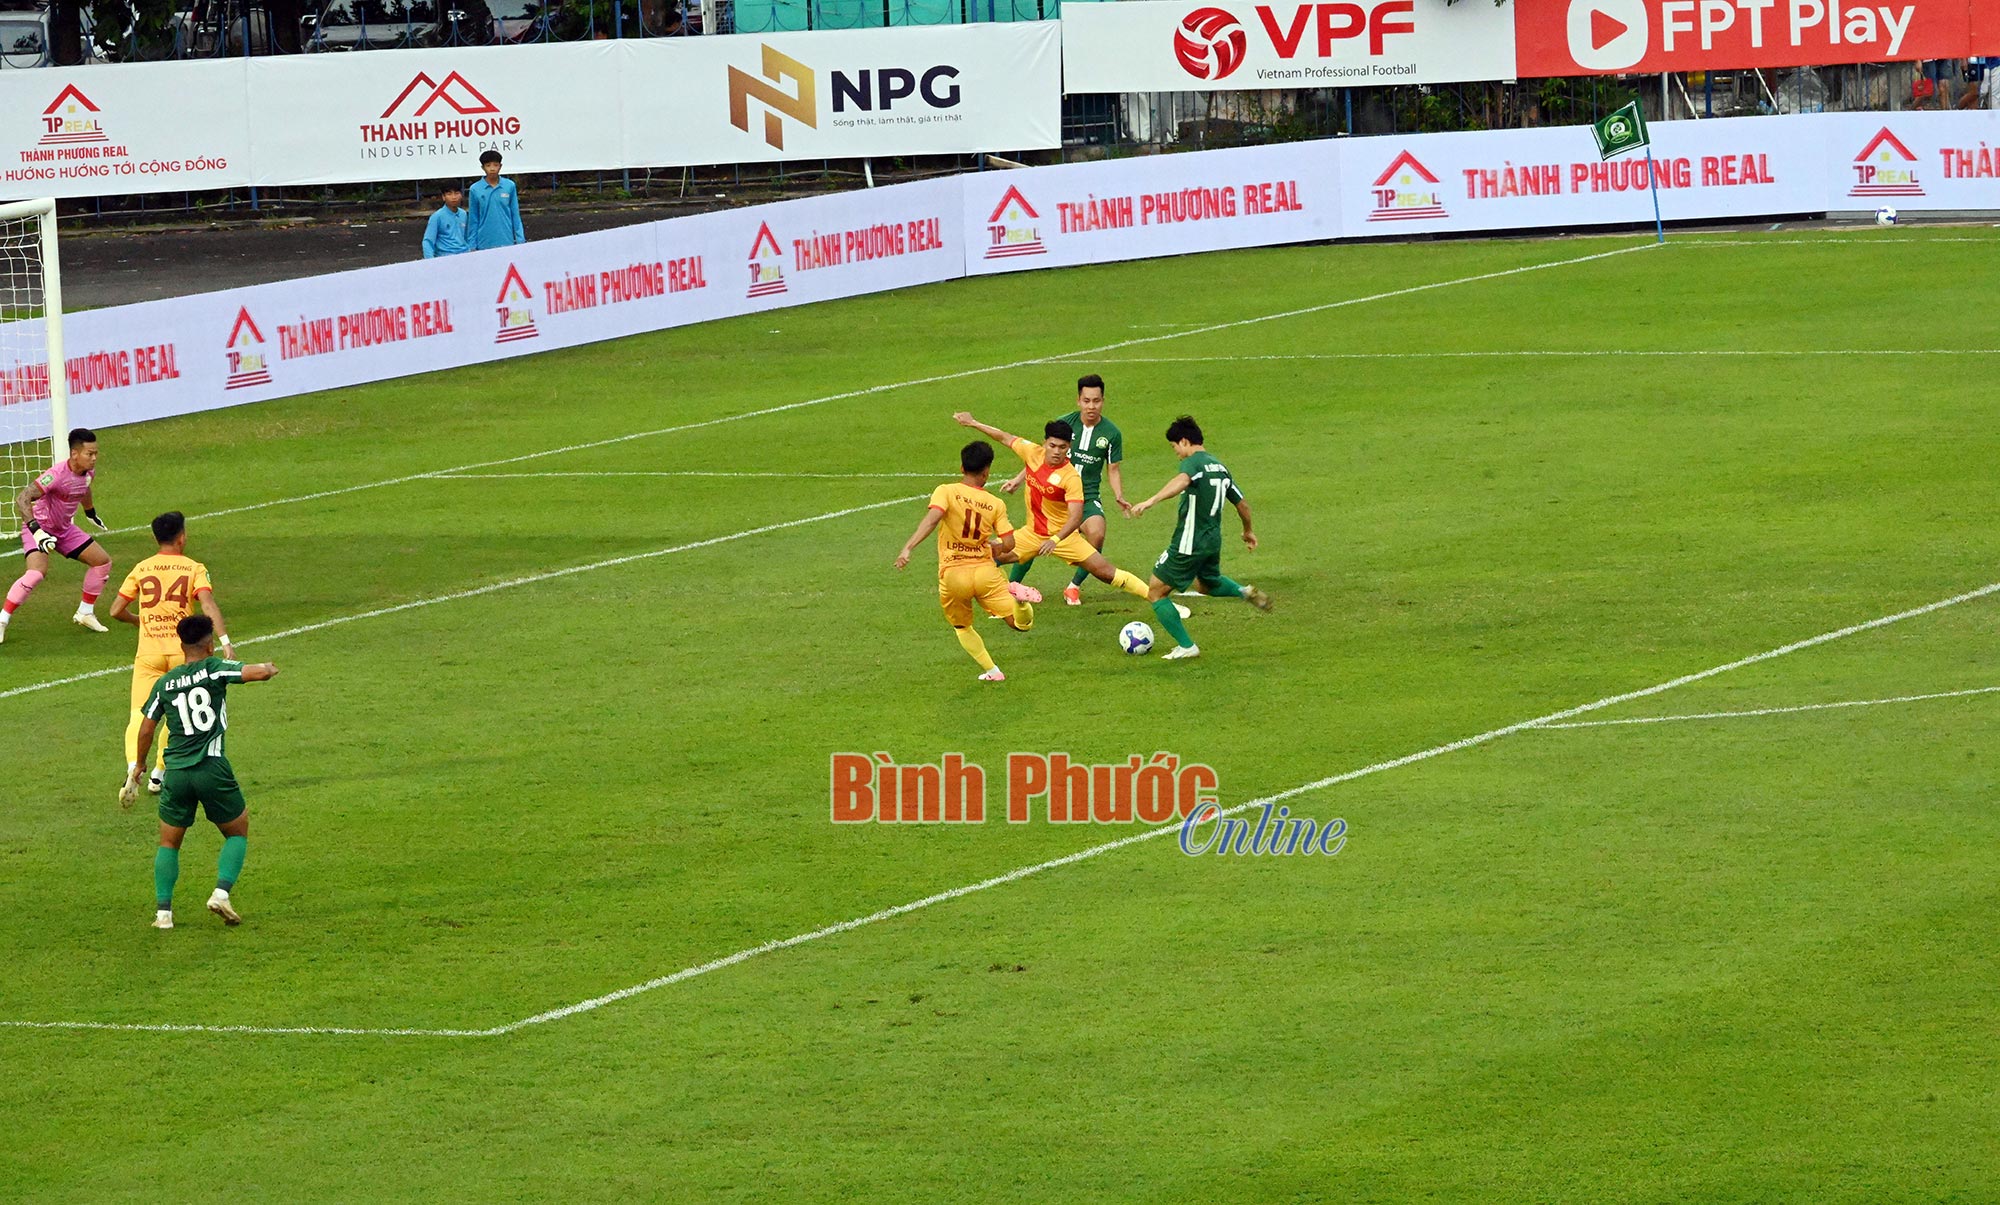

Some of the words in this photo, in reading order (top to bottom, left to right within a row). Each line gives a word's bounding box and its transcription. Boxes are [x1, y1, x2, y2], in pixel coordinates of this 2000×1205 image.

[1255, 1, 1414, 58] VPF
[1662, 0, 1774, 52] FPT
[1789, 0, 1915, 56] Play
[831, 65, 960, 112] NPG
[1257, 68, 1302, 79] Vietnam
[1305, 65, 1369, 78] Professional
[1372, 63, 1417, 76] Football
[360, 122, 428, 143] THANH
[434, 116, 521, 139] PHUONG
[360, 143, 468, 159] INDUSTRIAL
[479, 139, 524, 152] PARK
[20, 148, 54, 163] THÀNH
[58, 147, 100, 160] PHƯƠNG
[103, 145, 129, 158] REAL
[113, 160, 136, 175] TỚI
[139, 159, 181, 176] CỘNG
[1462, 161, 1561, 199] THÀNH
[1570, 156, 1692, 194] PHƯƠNG
[1700, 152, 1776, 186] REAL
[1939, 141, 2000, 179] THÀ
[1056, 193, 1133, 233] THÀNH
[1140, 186, 1237, 225] PHƯƠNG
[1243, 180, 1302, 216] REAL
[793, 230, 842, 271] THÀNH
[845, 223, 905, 263] PHƯƠNG
[907, 217, 943, 253] REAL
[544, 271, 597, 315] THÀNH
[600, 262, 665, 305] PHƯƠNG
[668, 255, 707, 293] REAL
[277, 315, 334, 360] THÀNH
[338, 305, 408, 350] PHƯƠNG
[410, 299, 454, 338] REAL
[134, 343, 180, 384] REAL
[961, 508, 982, 540] 11
[140, 575, 189, 609] 94
[171, 687, 216, 736] 18
